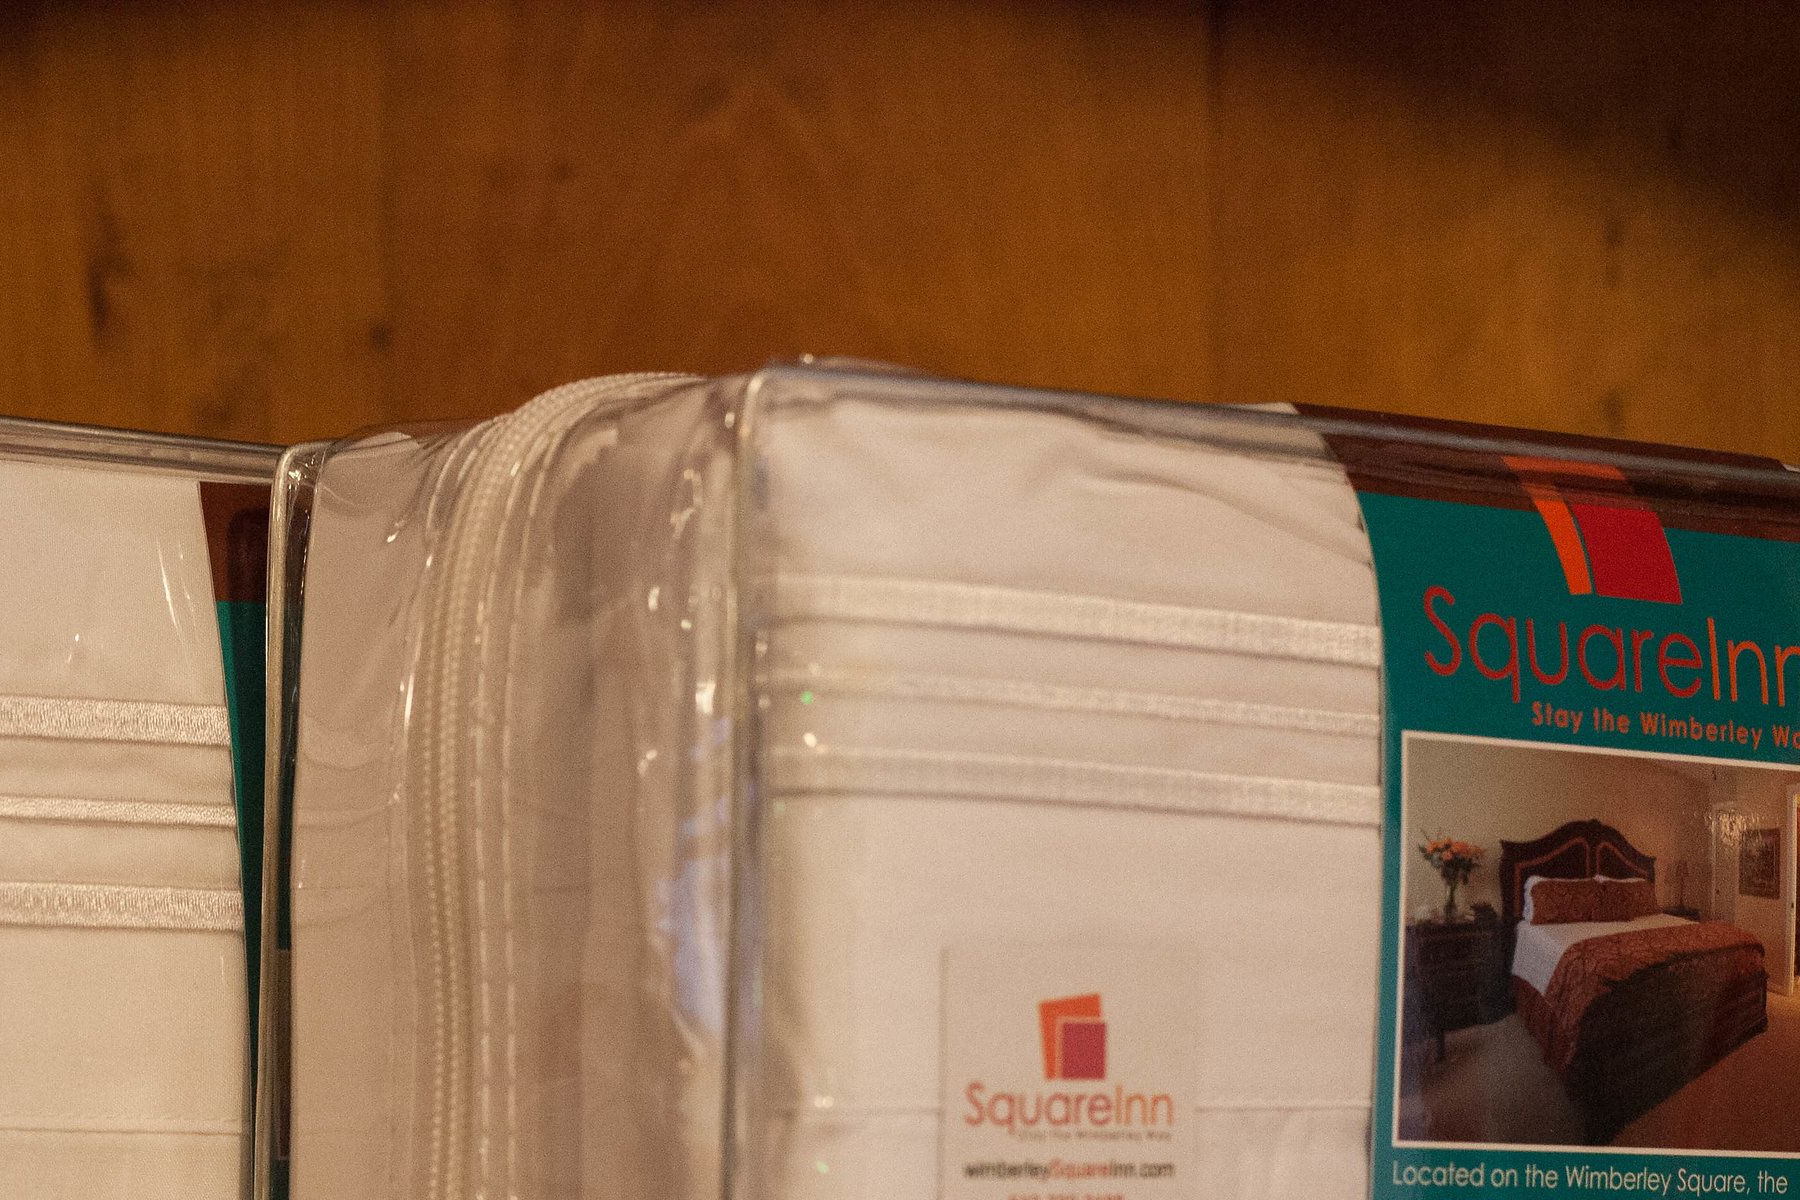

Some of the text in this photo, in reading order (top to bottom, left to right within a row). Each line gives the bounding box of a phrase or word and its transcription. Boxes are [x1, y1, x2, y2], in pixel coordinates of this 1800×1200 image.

[1532, 701, 1583, 734] Stay
[1593, 707, 1630, 734] the
[1640, 712, 1762, 750] Wimberley
[965, 1080, 1174, 1135] SquareInn
[1393, 1161, 1787, 1196] Located on the Wimberley Square, the
